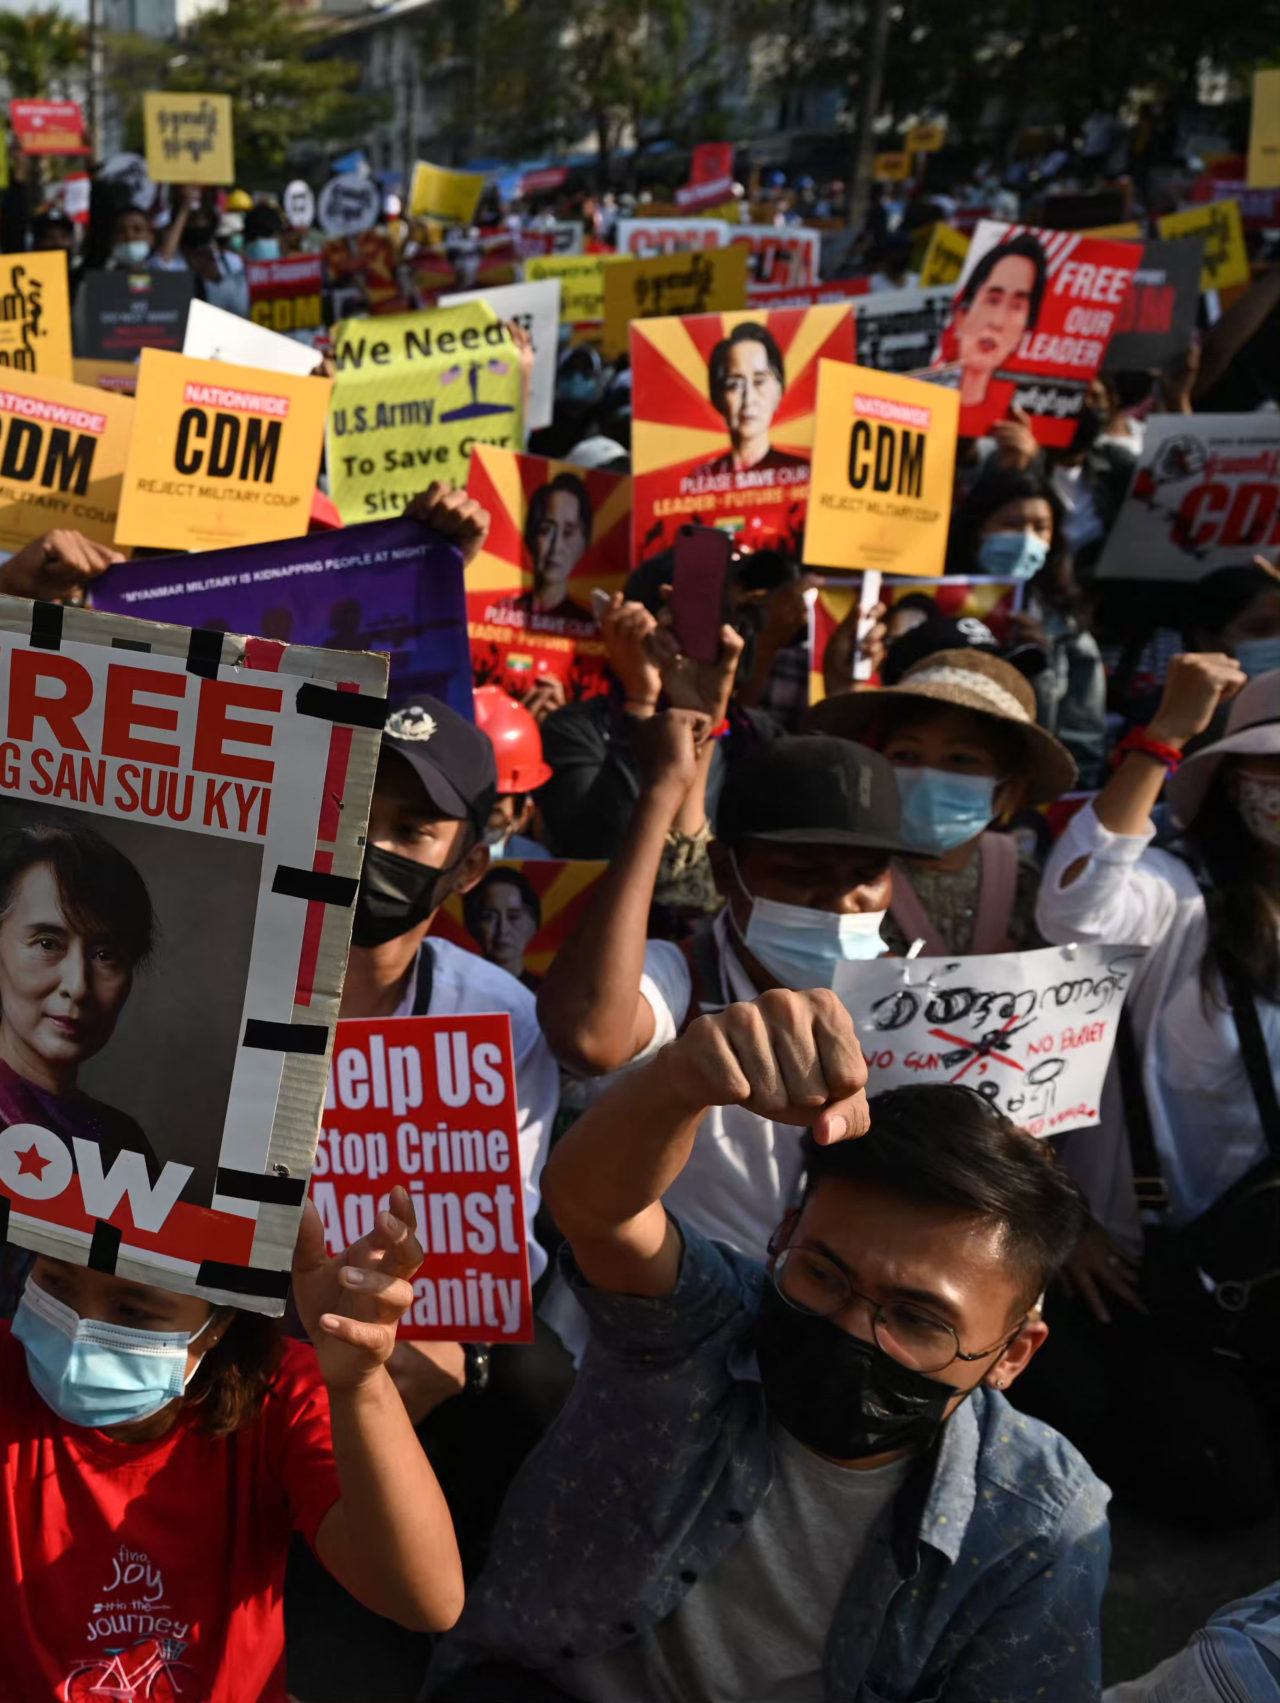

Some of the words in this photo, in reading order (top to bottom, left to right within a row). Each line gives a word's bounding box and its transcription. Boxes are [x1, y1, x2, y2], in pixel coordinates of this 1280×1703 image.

[1053, 262, 1129, 304] FREE
[1064, 305, 1114, 334] OUR
[334, 337, 391, 371] We
[404, 323, 506, 360] Need
[1019, 333, 1104, 368] LEADER
[184, 381, 290, 415] NATIONWIDE
[174, 408, 282, 484] CDM
[342, 455, 376, 479] To
[383, 445, 450, 473] Save
[848, 420, 926, 498] CDM
[136, 478, 196, 498] REJECT
[198, 485, 263, 504] MILITARY
[264, 492, 300, 508] COUP
[653, 495, 716, 517] LEADER
[724, 487, 783, 508] FUTURE
[679, 473, 731, 495] PLEASE
[735, 468, 776, 489] SAVE
[1169, 482, 1280, 551] CD
[185, 575, 238, 594] MILITARY
[239, 572, 252, 584] IS
[252, 560, 324, 583] KIDNAPPING
[324, 552, 372, 571] PEOPLE
[374, 551, 391, 563] AT
[29, 748, 107, 807] SAN
[113, 763, 196, 820] SUU
[202, 779, 272, 836] KYI
[1026, 1036, 1055, 1057] NO
[434, 1031, 506, 1108] Us
[396, 1122, 511, 1175] Crime
